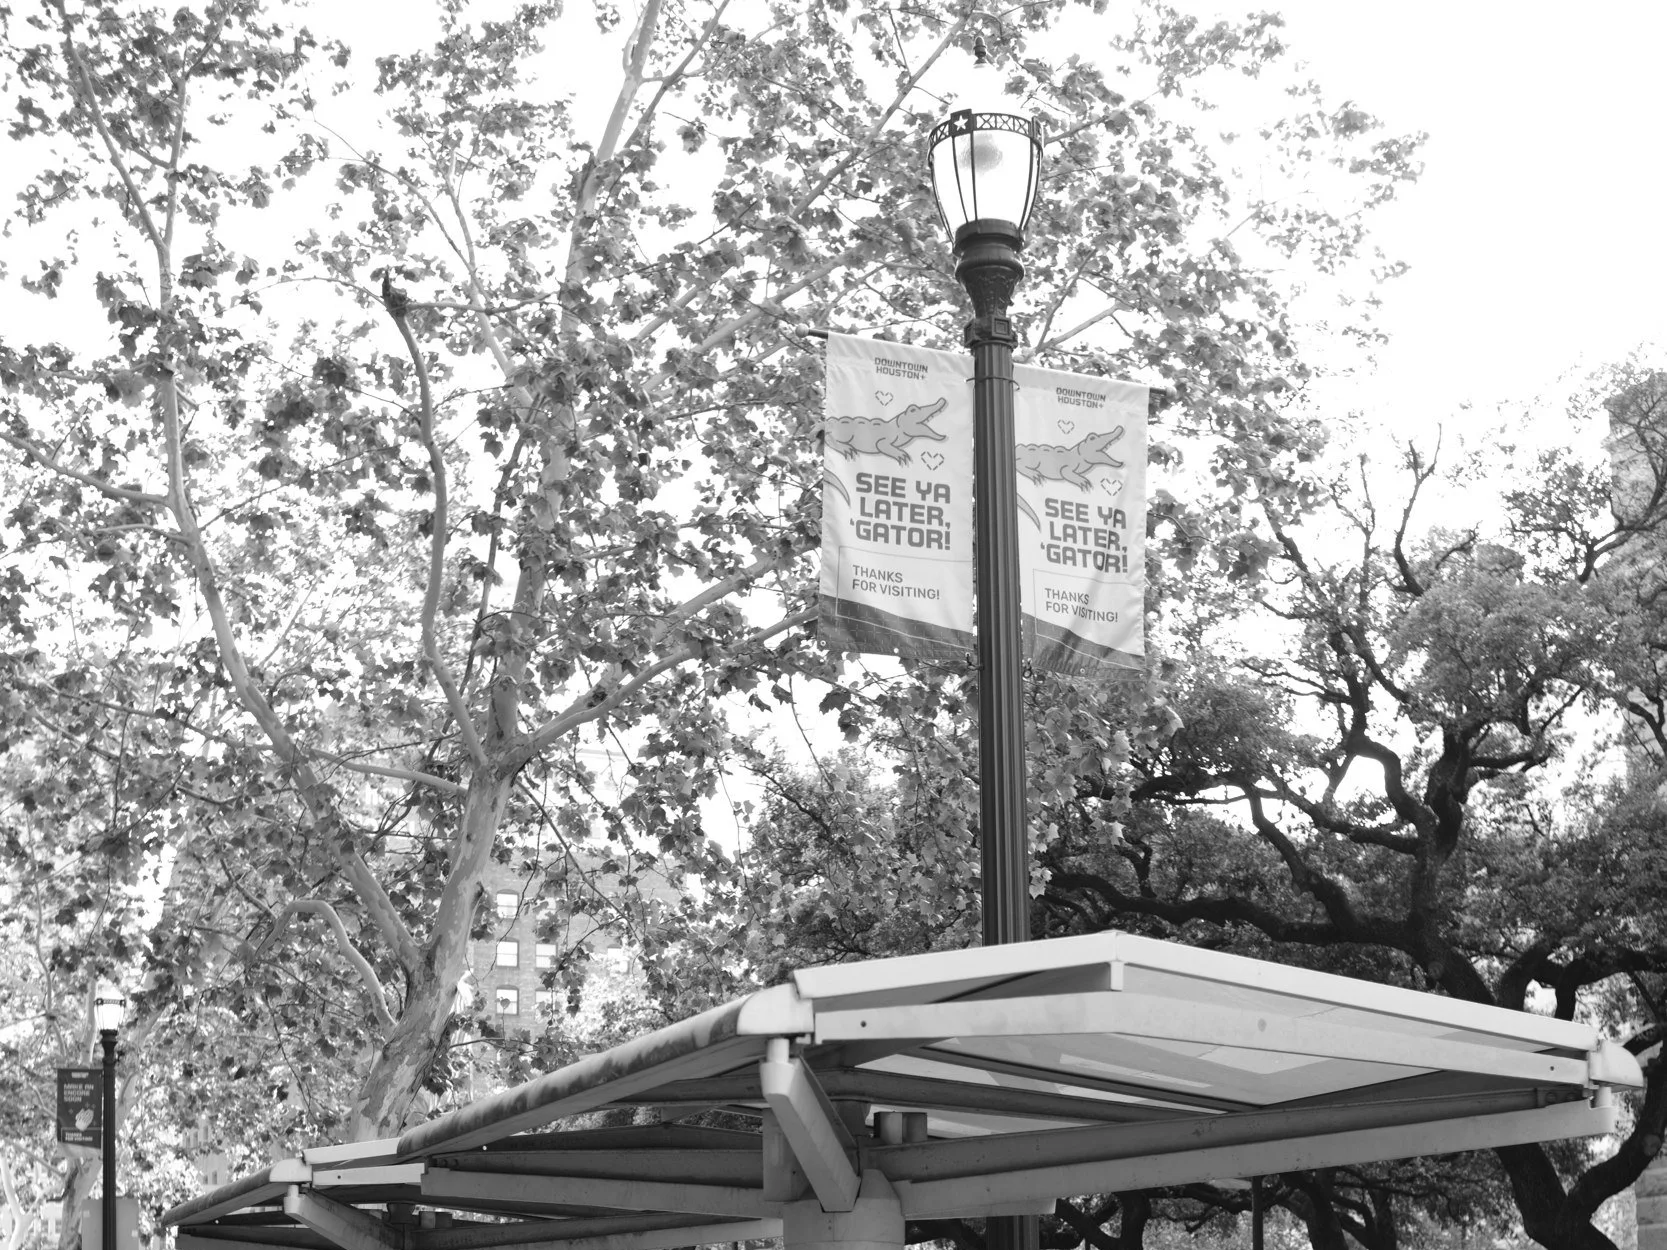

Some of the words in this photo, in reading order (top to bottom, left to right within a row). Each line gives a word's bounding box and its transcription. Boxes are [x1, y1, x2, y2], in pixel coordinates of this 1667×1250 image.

[874, 357, 928, 373] DOWNTOWN
[876, 366, 925, 380] HOUSTON+
[1056, 387, 1106, 402] DOWNTOWN
[1057, 395, 1104, 409] HOUSTON+
[855, 472, 907, 498] SEE
[915, 480, 951, 504] YA
[860, 496, 951, 530] LATER,
[1044, 497, 1090, 523] SEE
[1097, 506, 1126, 529] YA
[1049, 521, 1128, 553] LATER,
[852, 564, 904, 583] THANKS
[852, 578, 877, 593] FOR
[879, 583, 941, 600] VISITING!
[1044, 587, 1090, 605] THANKS
[1045, 601, 1069, 615] FOR
[1071, 604, 1119, 622] VISITING!
